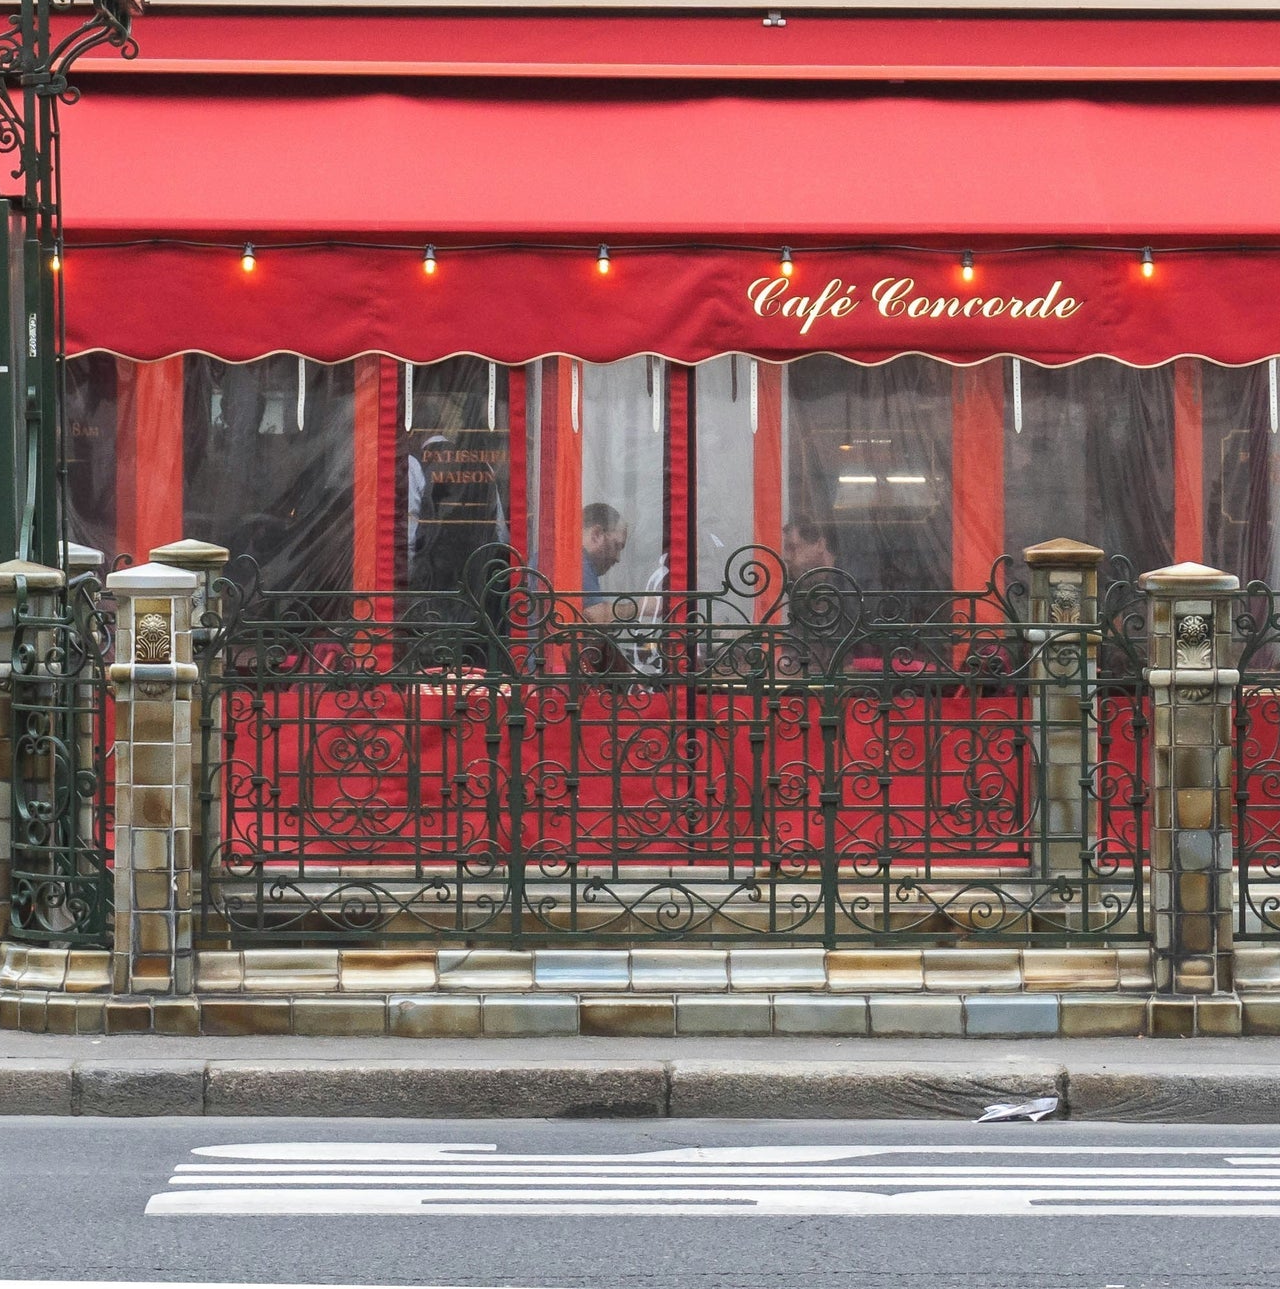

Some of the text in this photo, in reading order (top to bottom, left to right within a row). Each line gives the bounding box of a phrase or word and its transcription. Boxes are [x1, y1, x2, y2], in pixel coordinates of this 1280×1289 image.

[747, 277, 1084, 335] Café Concorde
[422, 450, 508, 463] PATISSERI
[431, 471, 496, 484] MAISON
